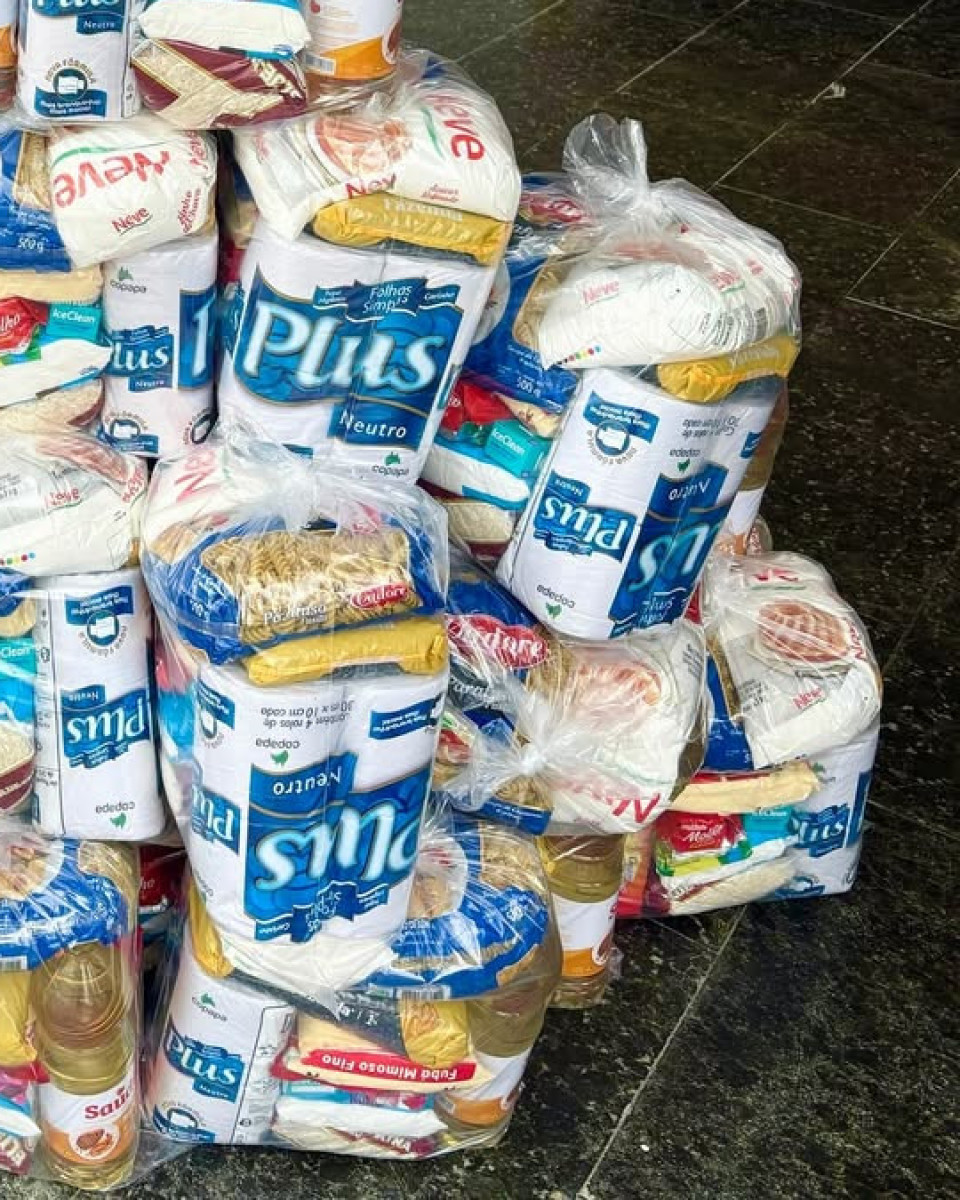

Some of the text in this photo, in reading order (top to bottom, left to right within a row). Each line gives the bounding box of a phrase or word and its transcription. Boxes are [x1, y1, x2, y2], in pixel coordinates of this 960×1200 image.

[51, 150, 171, 209] Neve
[111, 207, 151, 234] Neve
[109, 282, 147, 295] copapa
[369, 284, 413, 300] Folhas
[51, 309, 96, 325] IceClean
[112, 342, 171, 370] lus
[243, 302, 447, 392] Plus
[340, 414, 408, 439] Neutro
[370, 464, 410, 478] copapa
[542, 496, 630, 550] Plus
[535, 583, 576, 610] copapa
[67, 698, 146, 743] Plus
[305, 719, 313, 729] 4
[255, 738, 301, 751] copapa
[272, 766, 342, 797] Neutro
[94, 801, 136, 814] copapa
[191, 995, 229, 1022] copapa
[321, 1053, 355, 1071] Fino
[358, 1060, 418, 1080] Mimoso
